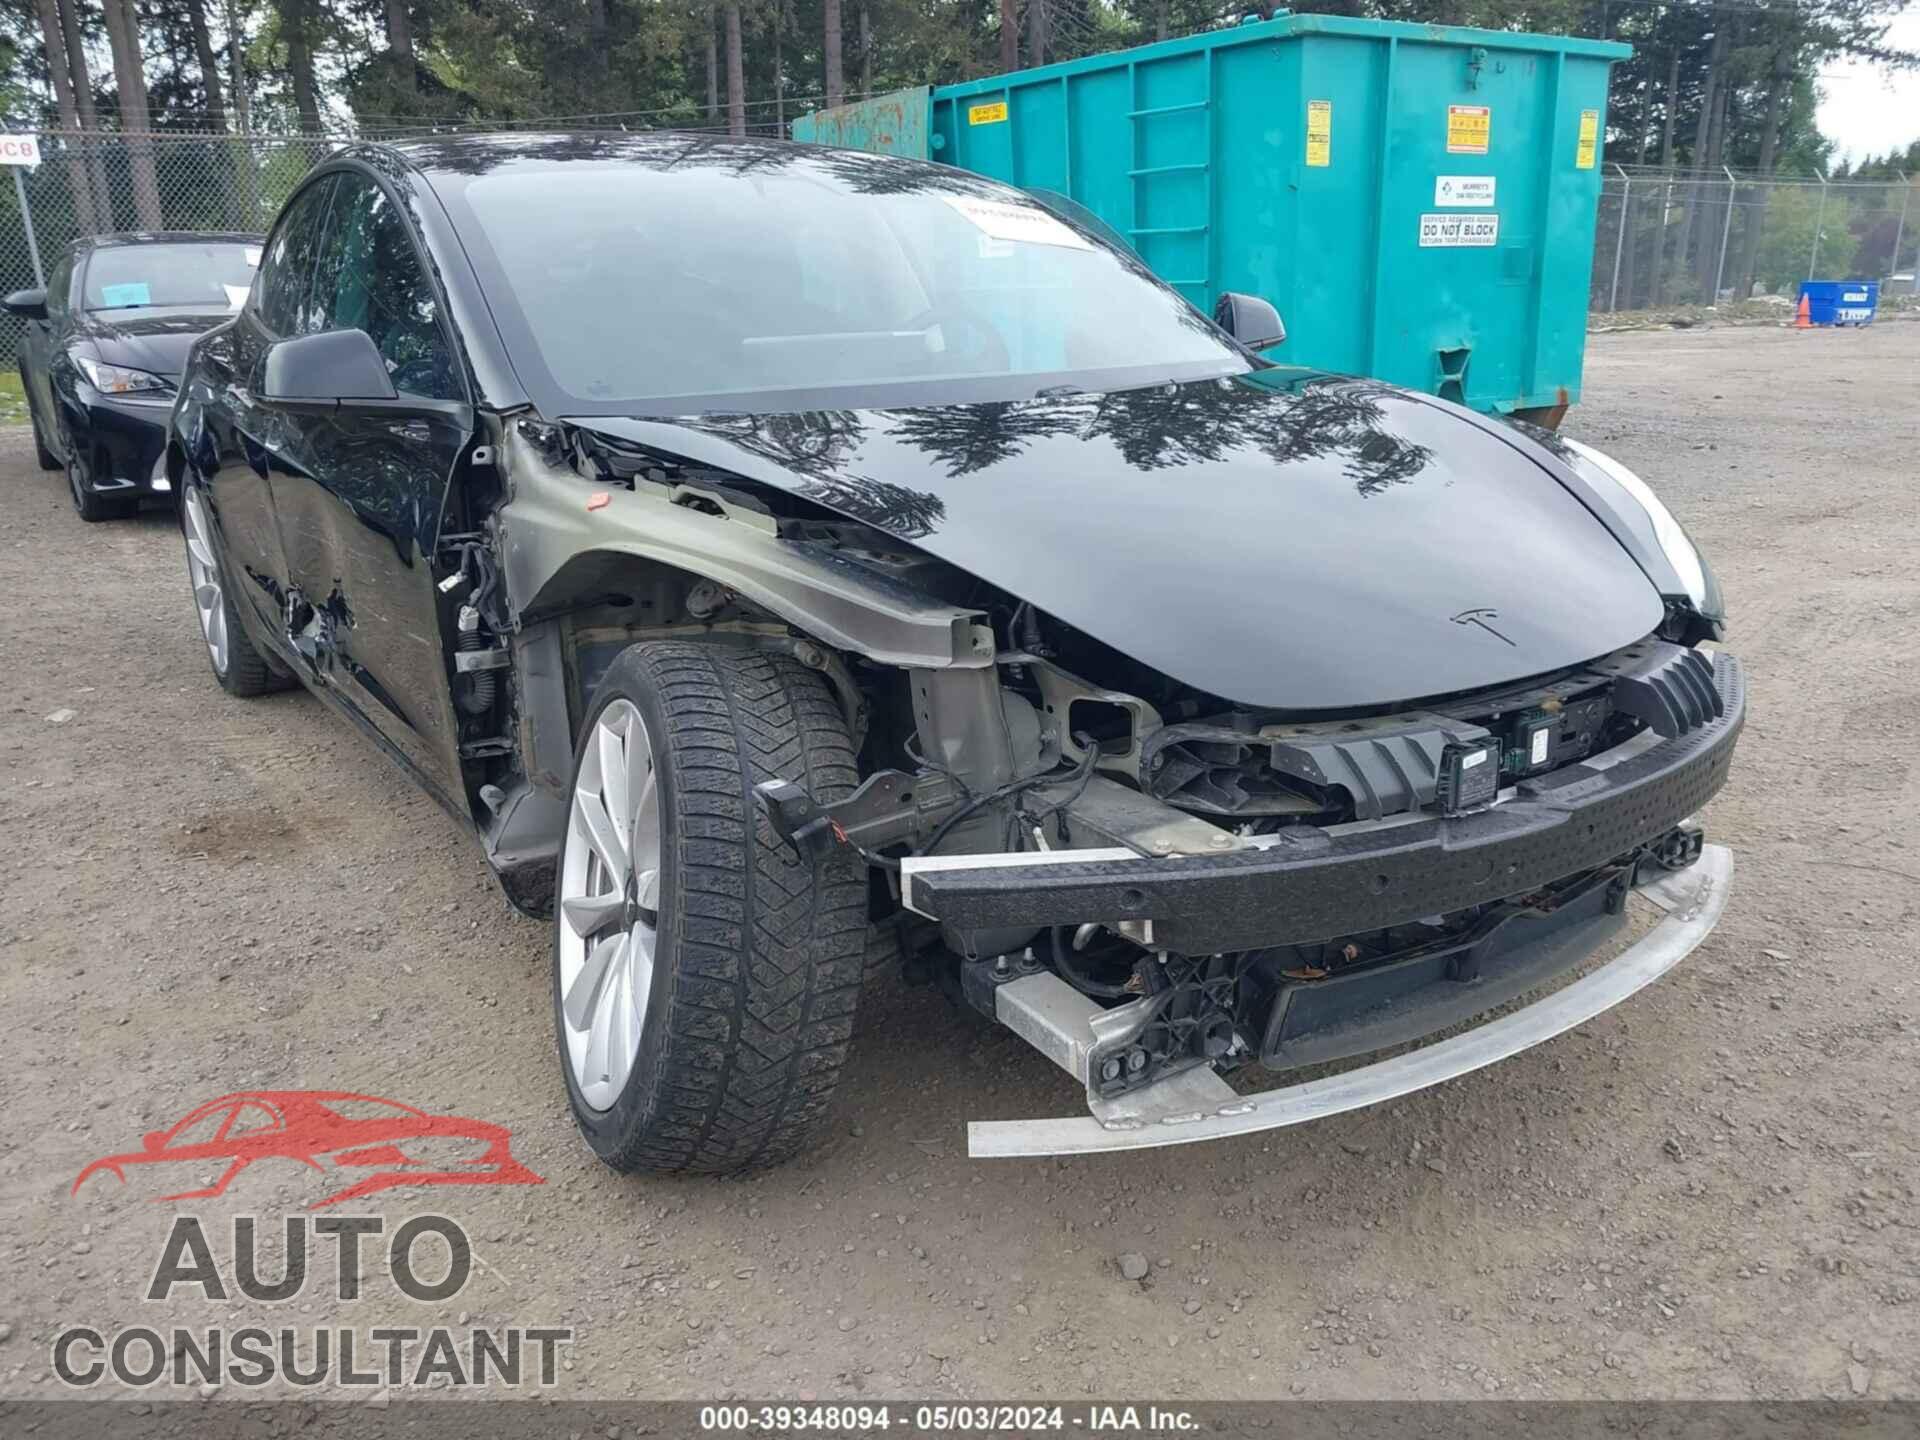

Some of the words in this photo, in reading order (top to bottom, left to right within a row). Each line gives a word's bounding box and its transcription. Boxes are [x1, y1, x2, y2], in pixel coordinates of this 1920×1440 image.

[1423, 224, 1438, 236] DO
[1441, 224, 1461, 236] NOT
[1464, 224, 1495, 236] BLOCK
